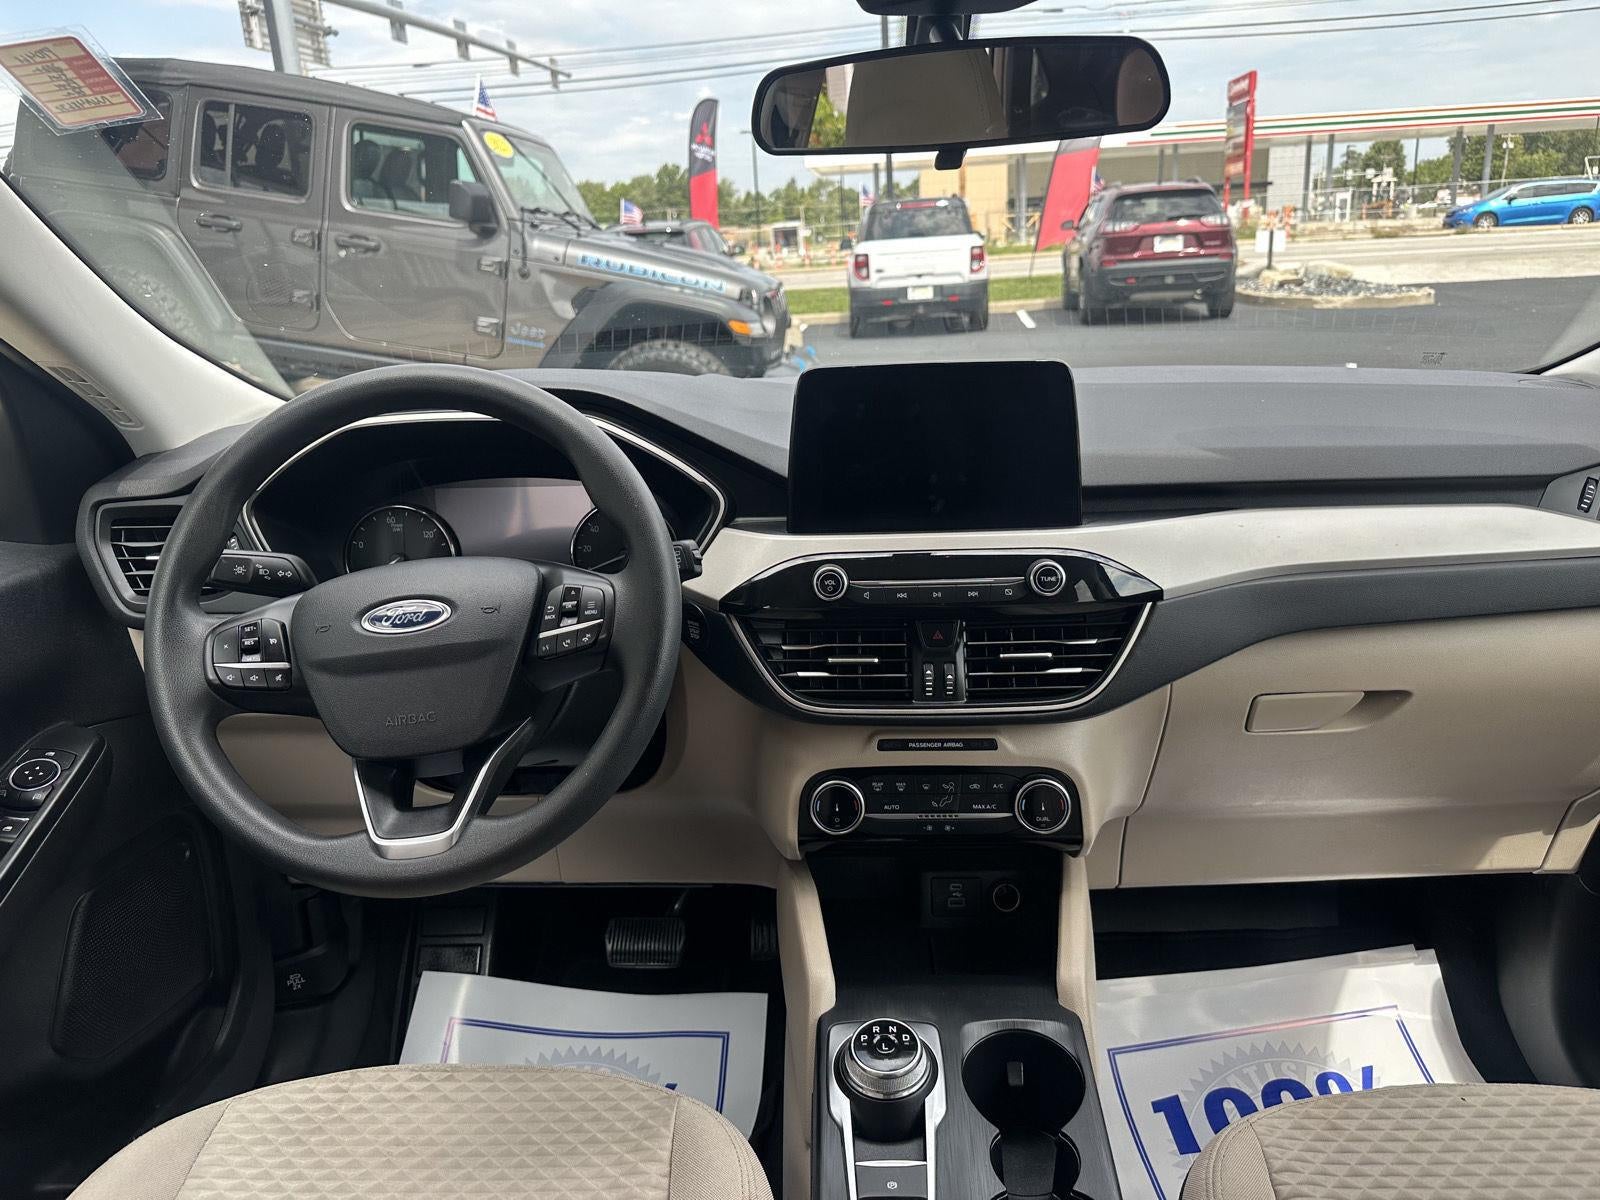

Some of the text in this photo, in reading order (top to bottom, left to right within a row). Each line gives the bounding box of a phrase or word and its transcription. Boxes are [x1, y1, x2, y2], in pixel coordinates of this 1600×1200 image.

[576, 253, 727, 294] RUBICON
[510, 322, 546, 339] Jeep
[386, 516, 396, 524] 60
[423, 530, 434, 538] 120
[583, 544, 592, 552] 20
[381, 605, 427, 626] Ford
[385, 711, 438, 727] AIRBAG
[888, 1025, 897, 1033] N
[860, 1034, 868, 1042] P
[881, 1042, 889, 1050] L
